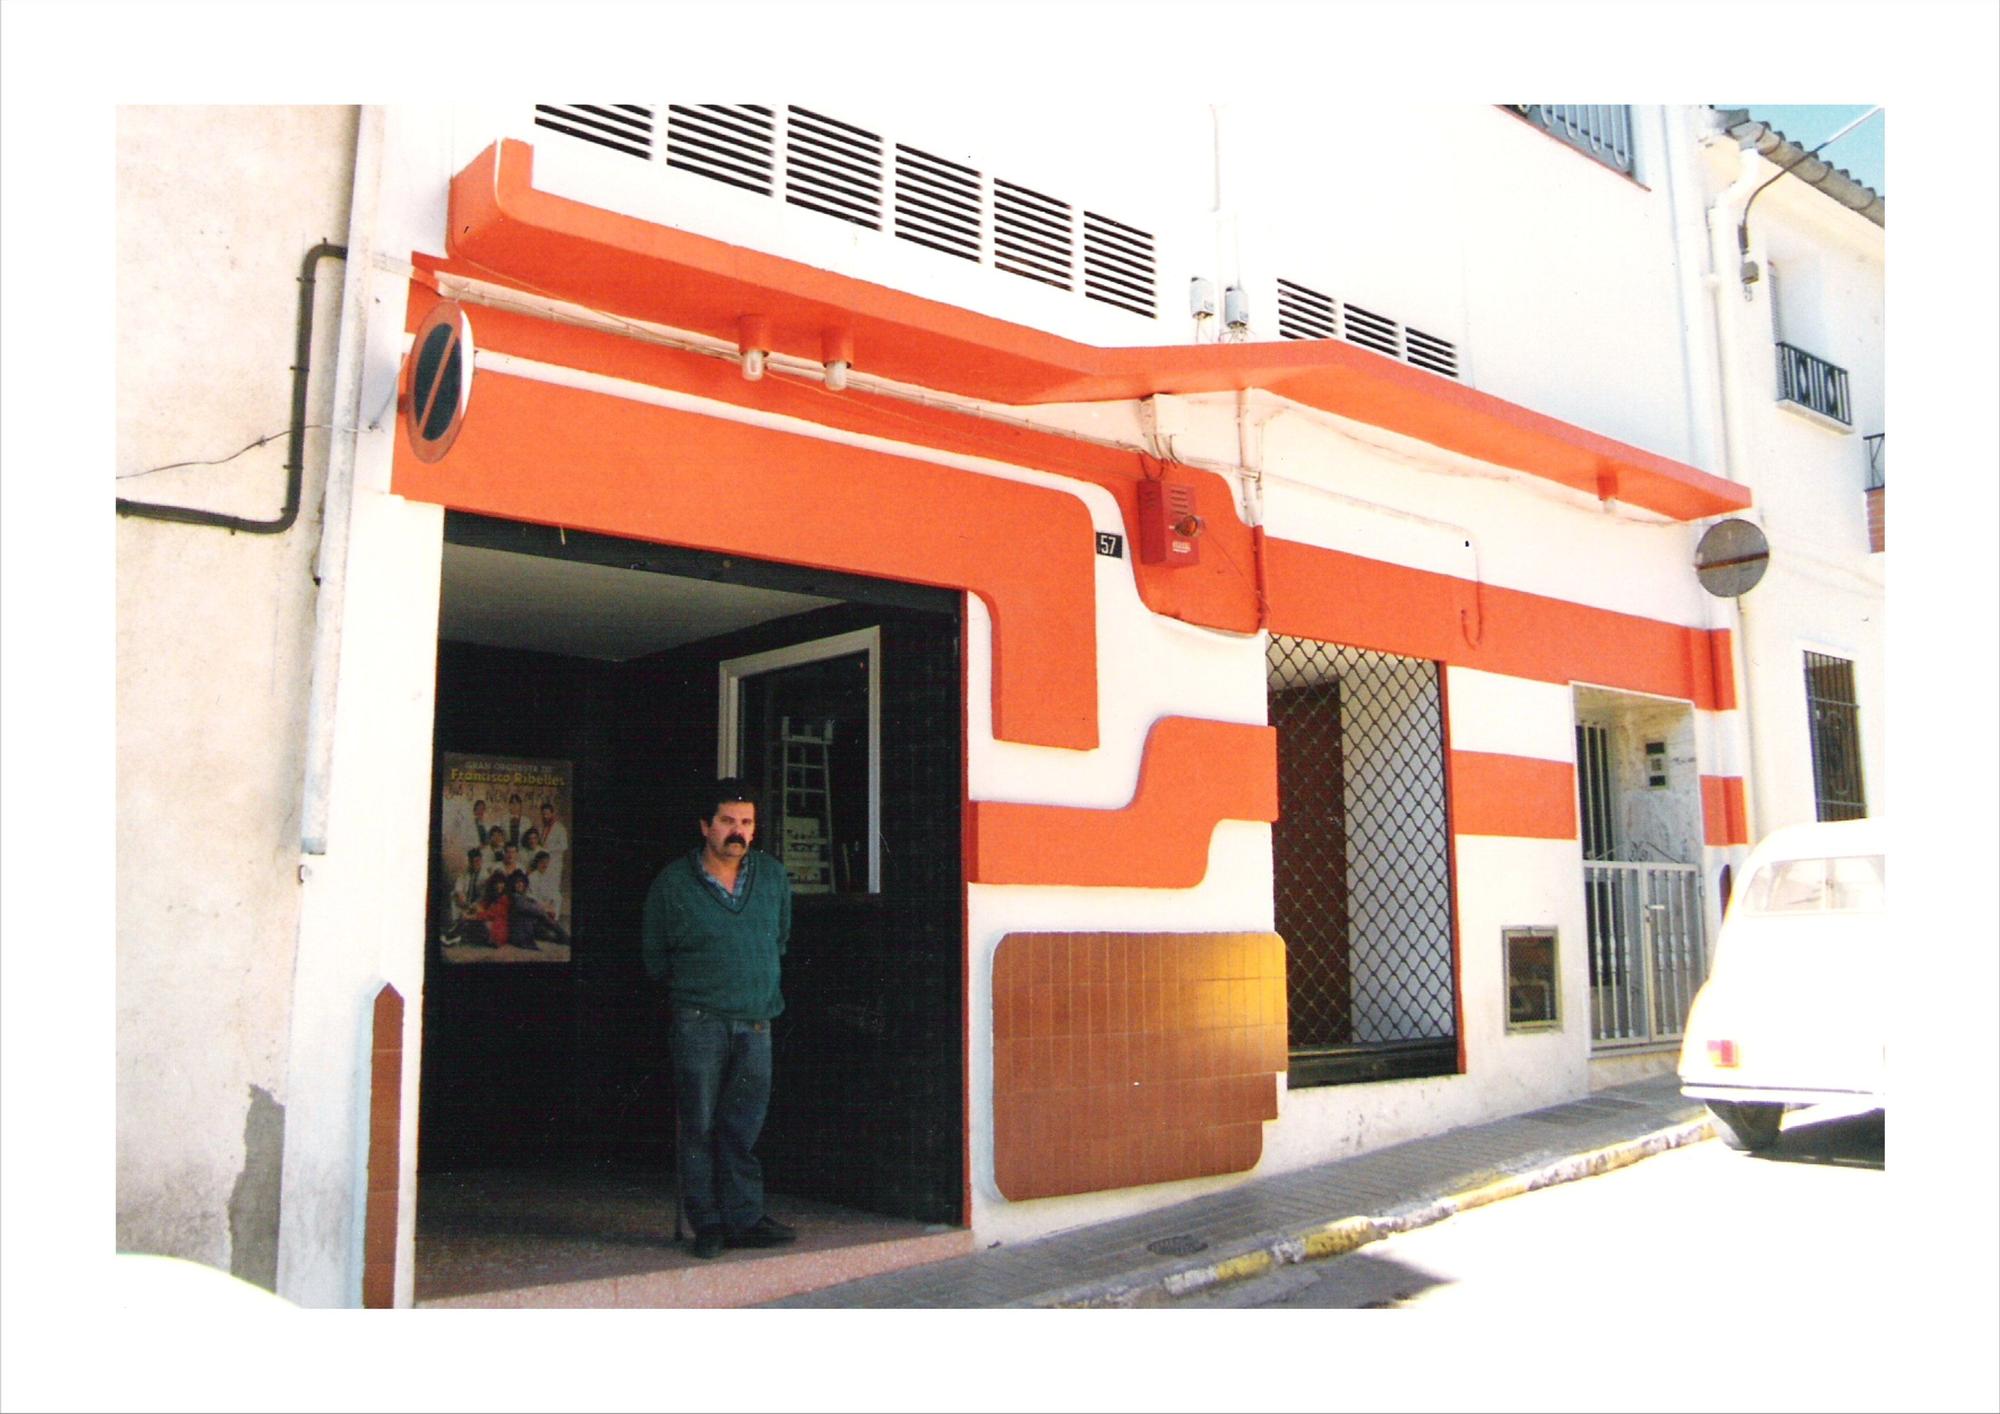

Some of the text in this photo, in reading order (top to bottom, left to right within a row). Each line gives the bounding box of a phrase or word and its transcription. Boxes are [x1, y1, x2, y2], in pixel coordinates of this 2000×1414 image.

[1100, 534, 1117, 555] 57
[464, 760, 490, 770] GRAN
[450, 767, 566, 787] Francisco Ribelles
